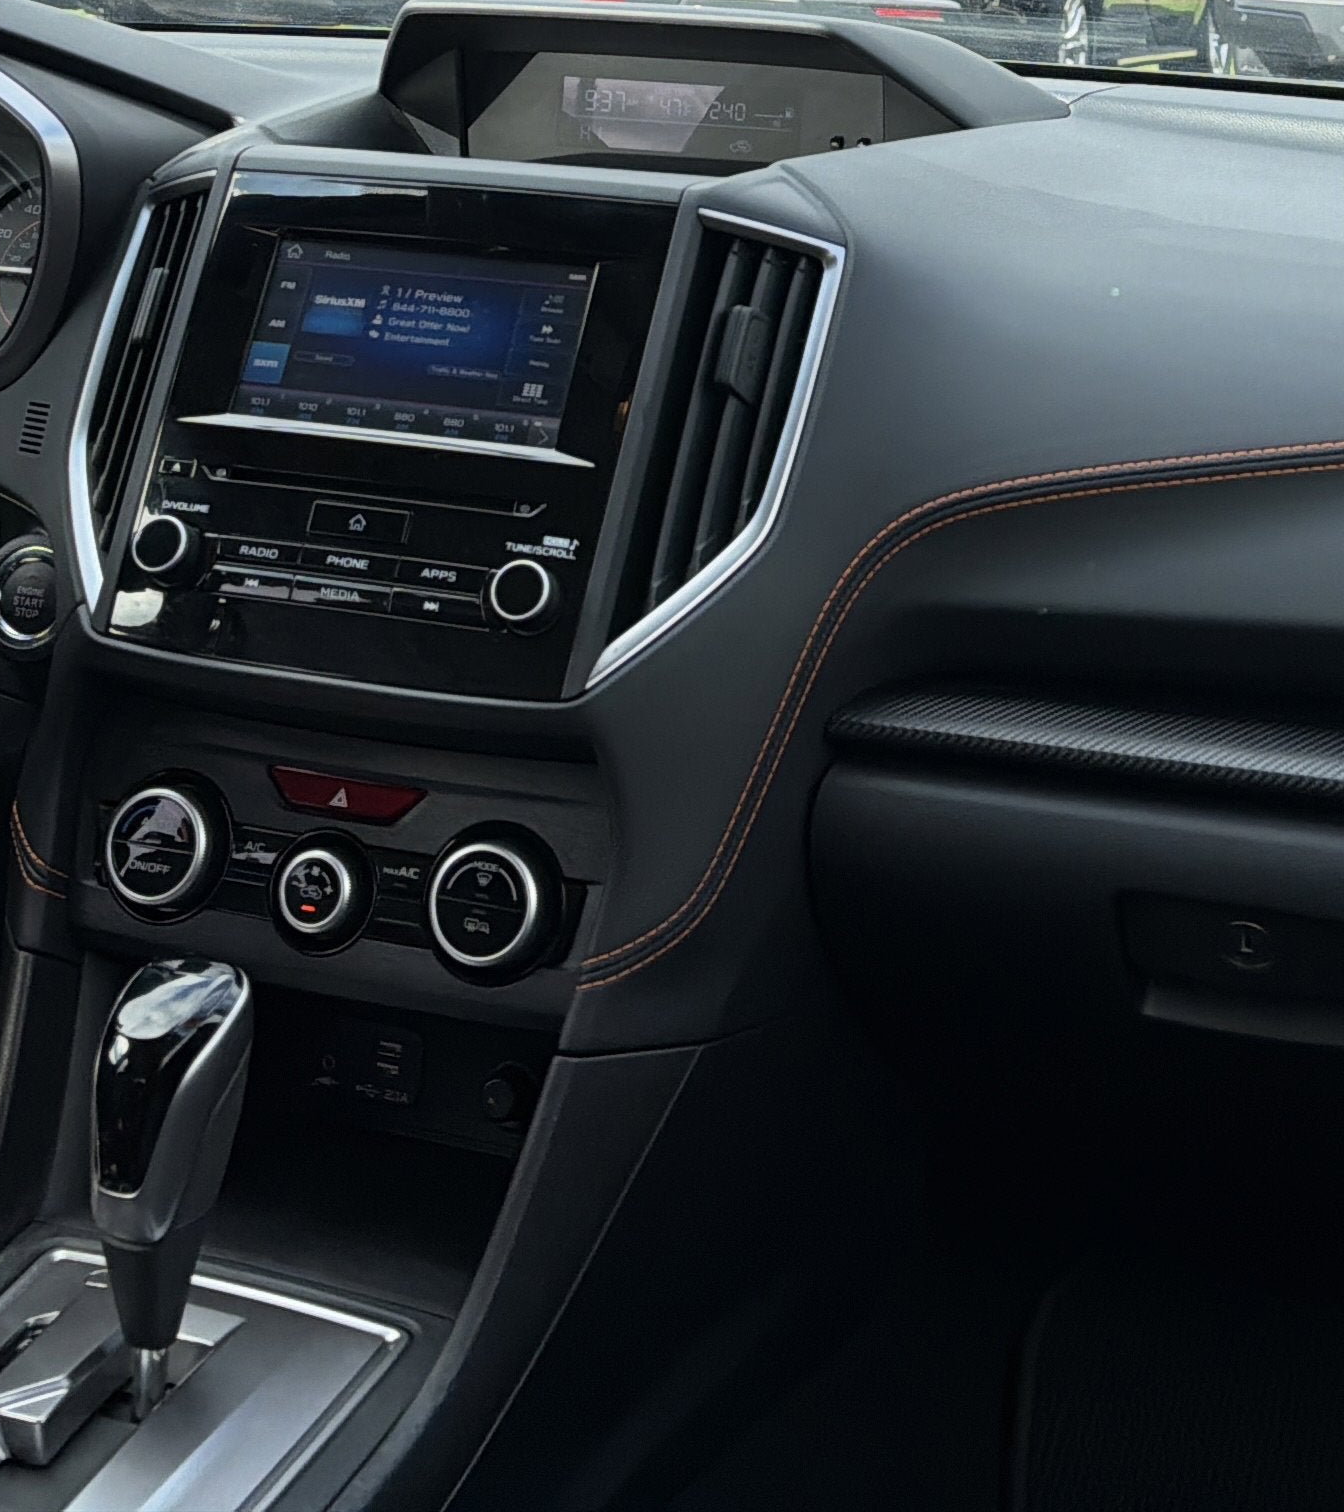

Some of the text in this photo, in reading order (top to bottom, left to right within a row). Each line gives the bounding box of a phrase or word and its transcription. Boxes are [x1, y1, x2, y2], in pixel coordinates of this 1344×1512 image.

[709, 102, 747, 122] 240
[325, 249, 351, 260] Radio
[280, 280, 297, 289] FM
[314, 294, 366, 308] SiriusXM
[414, 289, 464, 304] Preview
[392, 302, 471, 318] 844-711-8800
[268, 318, 286, 328] AM
[388, 317, 471, 333] Great Offer Now!
[384, 332, 450, 347] Entertainment
[239, 545, 279, 559] RADIO
[505, 541, 576, 560] TUNE/SCROLL
[326, 554, 370, 570] PHONE
[420, 567, 457, 582] APPS
[12, 596, 45, 608] START
[320, 587, 360, 602] MEDIA
[15, 607, 39, 619] STOP
[244, 841, 267, 853] A/C
[128, 859, 172, 875] ON/OFF
